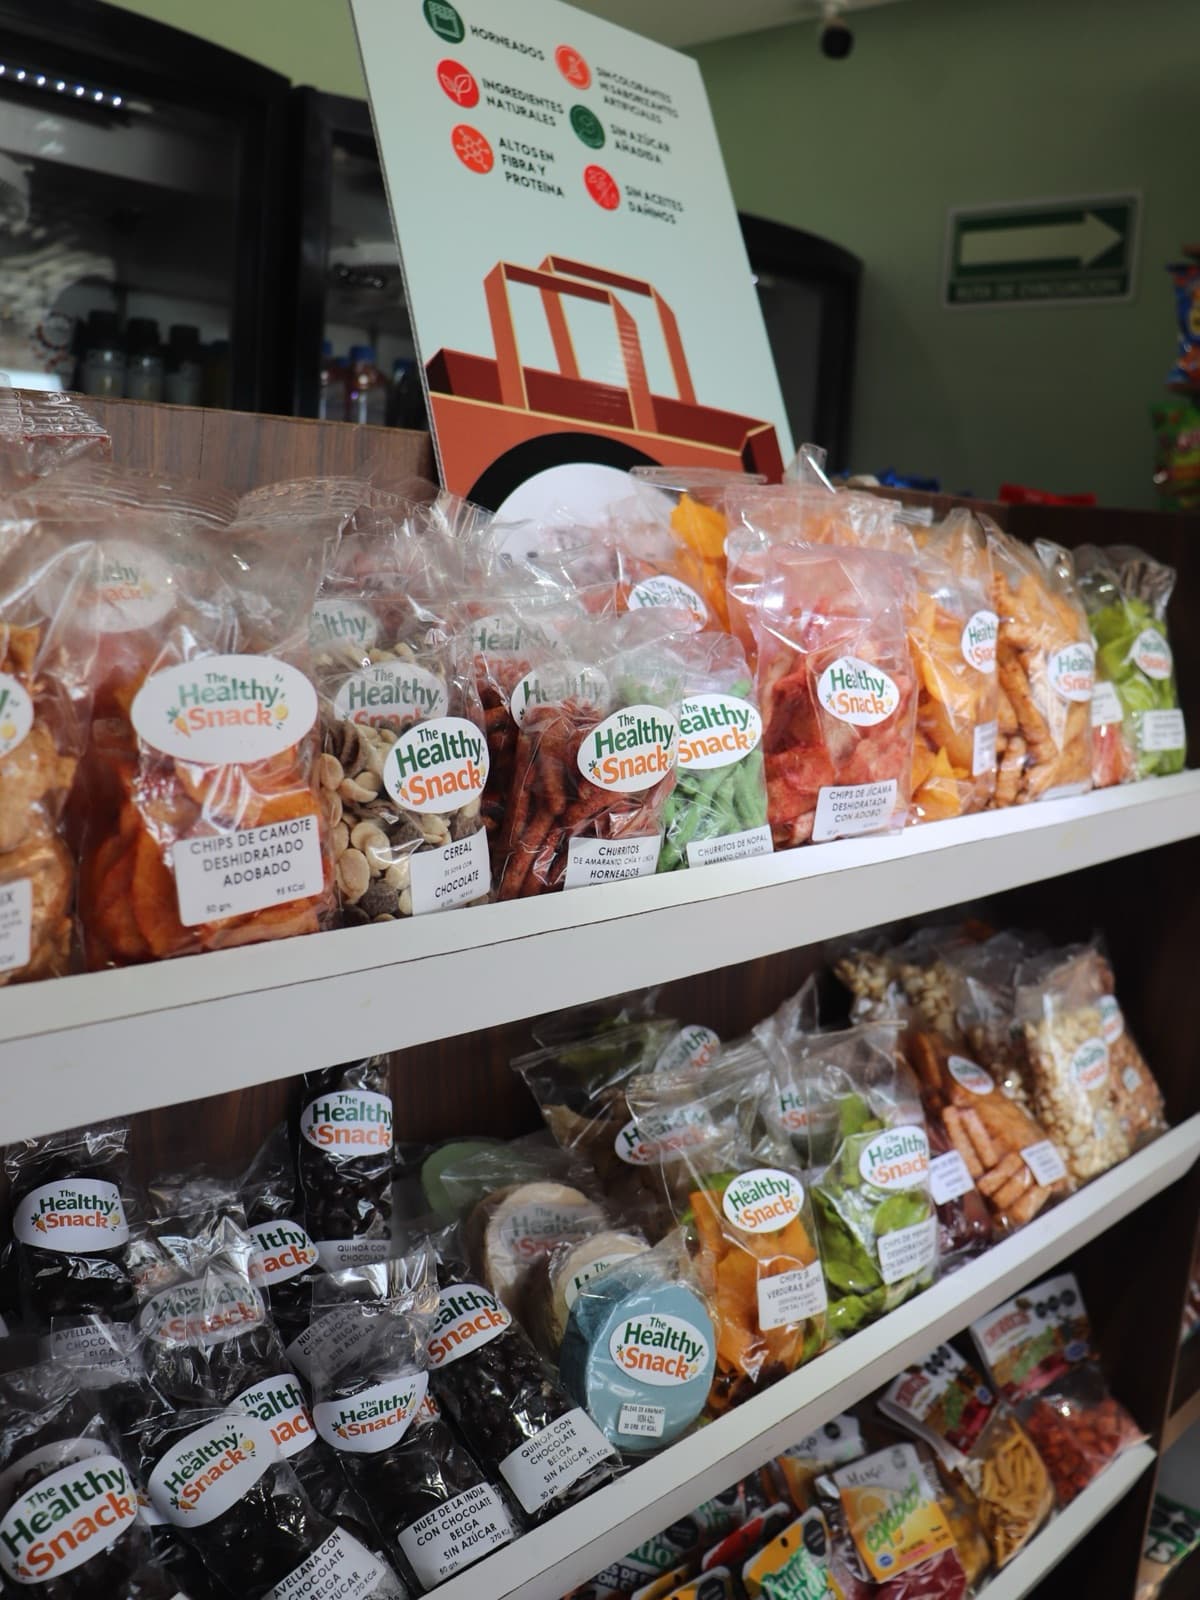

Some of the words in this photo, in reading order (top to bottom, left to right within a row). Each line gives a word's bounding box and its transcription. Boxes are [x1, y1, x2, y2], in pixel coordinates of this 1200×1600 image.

[470, 24, 545, 61] HORNEADOS
[481, 78, 564, 114] INGREDIENTES
[486, 95, 556, 127] NATURALES
[499, 137, 538, 158] ALTOS
[539, 149, 555, 163] EN
[501, 153, 537, 174] FIBRA
[537, 163, 546, 176] Y
[504, 171, 565, 198] PROTEINA
[205, 672, 228, 684] The
[374, 668, 394, 682] The
[830, 668, 885, 699] Healthy
[177, 677, 280, 709] Healthy
[348, 676, 440, 715] Healthy
[837, 693, 888, 716] Snack
[187, 702, 274, 732] Snack
[617, 713, 636, 728] The
[679, 703, 750, 736] ealthy
[417, 727, 439, 744] The
[594, 716, 675, 760] Healthy
[394, 729, 484, 779] Healthy
[602, 744, 669, 786] Snack
[408, 759, 483, 806] Snack
[829, 790, 854, 801] CHIPS
[855, 789, 865, 799] DE
[834, 813, 852, 823] CON
[190, 836, 235, 856] CHIPS
[237, 831, 255, 848] DE
[258, 818, 312, 843] CAMOTE
[443, 841, 473, 862] CEREAL
[598, 844, 640, 857] CHURRITOS
[697, 843, 736, 858] CHURRITOS
[737, 840, 746, 852] DE
[746, 834, 769, 849] NOPAL
[202, 838, 304, 873] DESHIDRATADO
[573, 856, 584, 865] DE
[584, 856, 622, 867] AMARANTO
[222, 859, 292, 887] ADOBADO
[434, 869, 480, 899] CHOCOLATE
[590, 866, 640, 880] HORNEADOS
[337, 1094, 359, 1106] The
[312, 1100, 394, 1131] Healthy
[317, 1123, 392, 1148] Snack
[39, 1194, 115, 1217] Healthy
[59, 1190, 77, 1199] The
[727, 1176, 792, 1212] Healthy
[45, 1211, 108, 1231] Snack
[743, 1195, 797, 1229] Snack
[337, 1243, 369, 1254] QUINOA
[370, 1244, 387, 1253] CON
[175, 1286, 199, 1300] The
[427, 1306, 508, 1364] Snack
[650, 1316, 668, 1330] The
[624, 1322, 704, 1363] Healthy
[624, 1346, 691, 1380] Snack
[240, 1390, 265, 1408] The
[339, 1391, 413, 1425] Healthy
[360, 1399, 378, 1410] The
[347, 1407, 409, 1437] Snack
[521, 1432, 554, 1458] QUINOA
[552, 1418, 573, 1435] CON
[529, 1427, 577, 1466] CHOCOLATE
[163, 1432, 240, 1496] Healthy
[175, 1450, 195, 1466] The
[543, 1469, 558, 1484] SIN
[558, 1446, 589, 1474] AZÚCAR
[546, 1445, 574, 1468] BELGA
[182, 1449, 248, 1504] Snack
[0, 1467, 127, 1558] Healthy
[26, 1487, 57, 1509] The
[412, 1513, 438, 1534] NUEZ
[437, 1504, 452, 1518] DE
[451, 1499, 464, 1511] LA
[463, 1486, 486, 1504] INDIA
[26, 1492, 136, 1577] Snack
[416, 1529, 441, 1547] CON
[441, 1496, 493, 1531] CHOCOLATE
[449, 1518, 481, 1542] BELGA
[443, 1545, 460, 1561] SIN
[461, 1522, 498, 1551] AZÚCAR
[489, 1532, 503, 1544] 270
[273, 1554, 323, 1599] AVELLANA
[320, 1531, 341, 1556] CON
[288, 1548, 345, 1600] CHOCOLATE
[309, 1573, 341, 1600] BELGA
